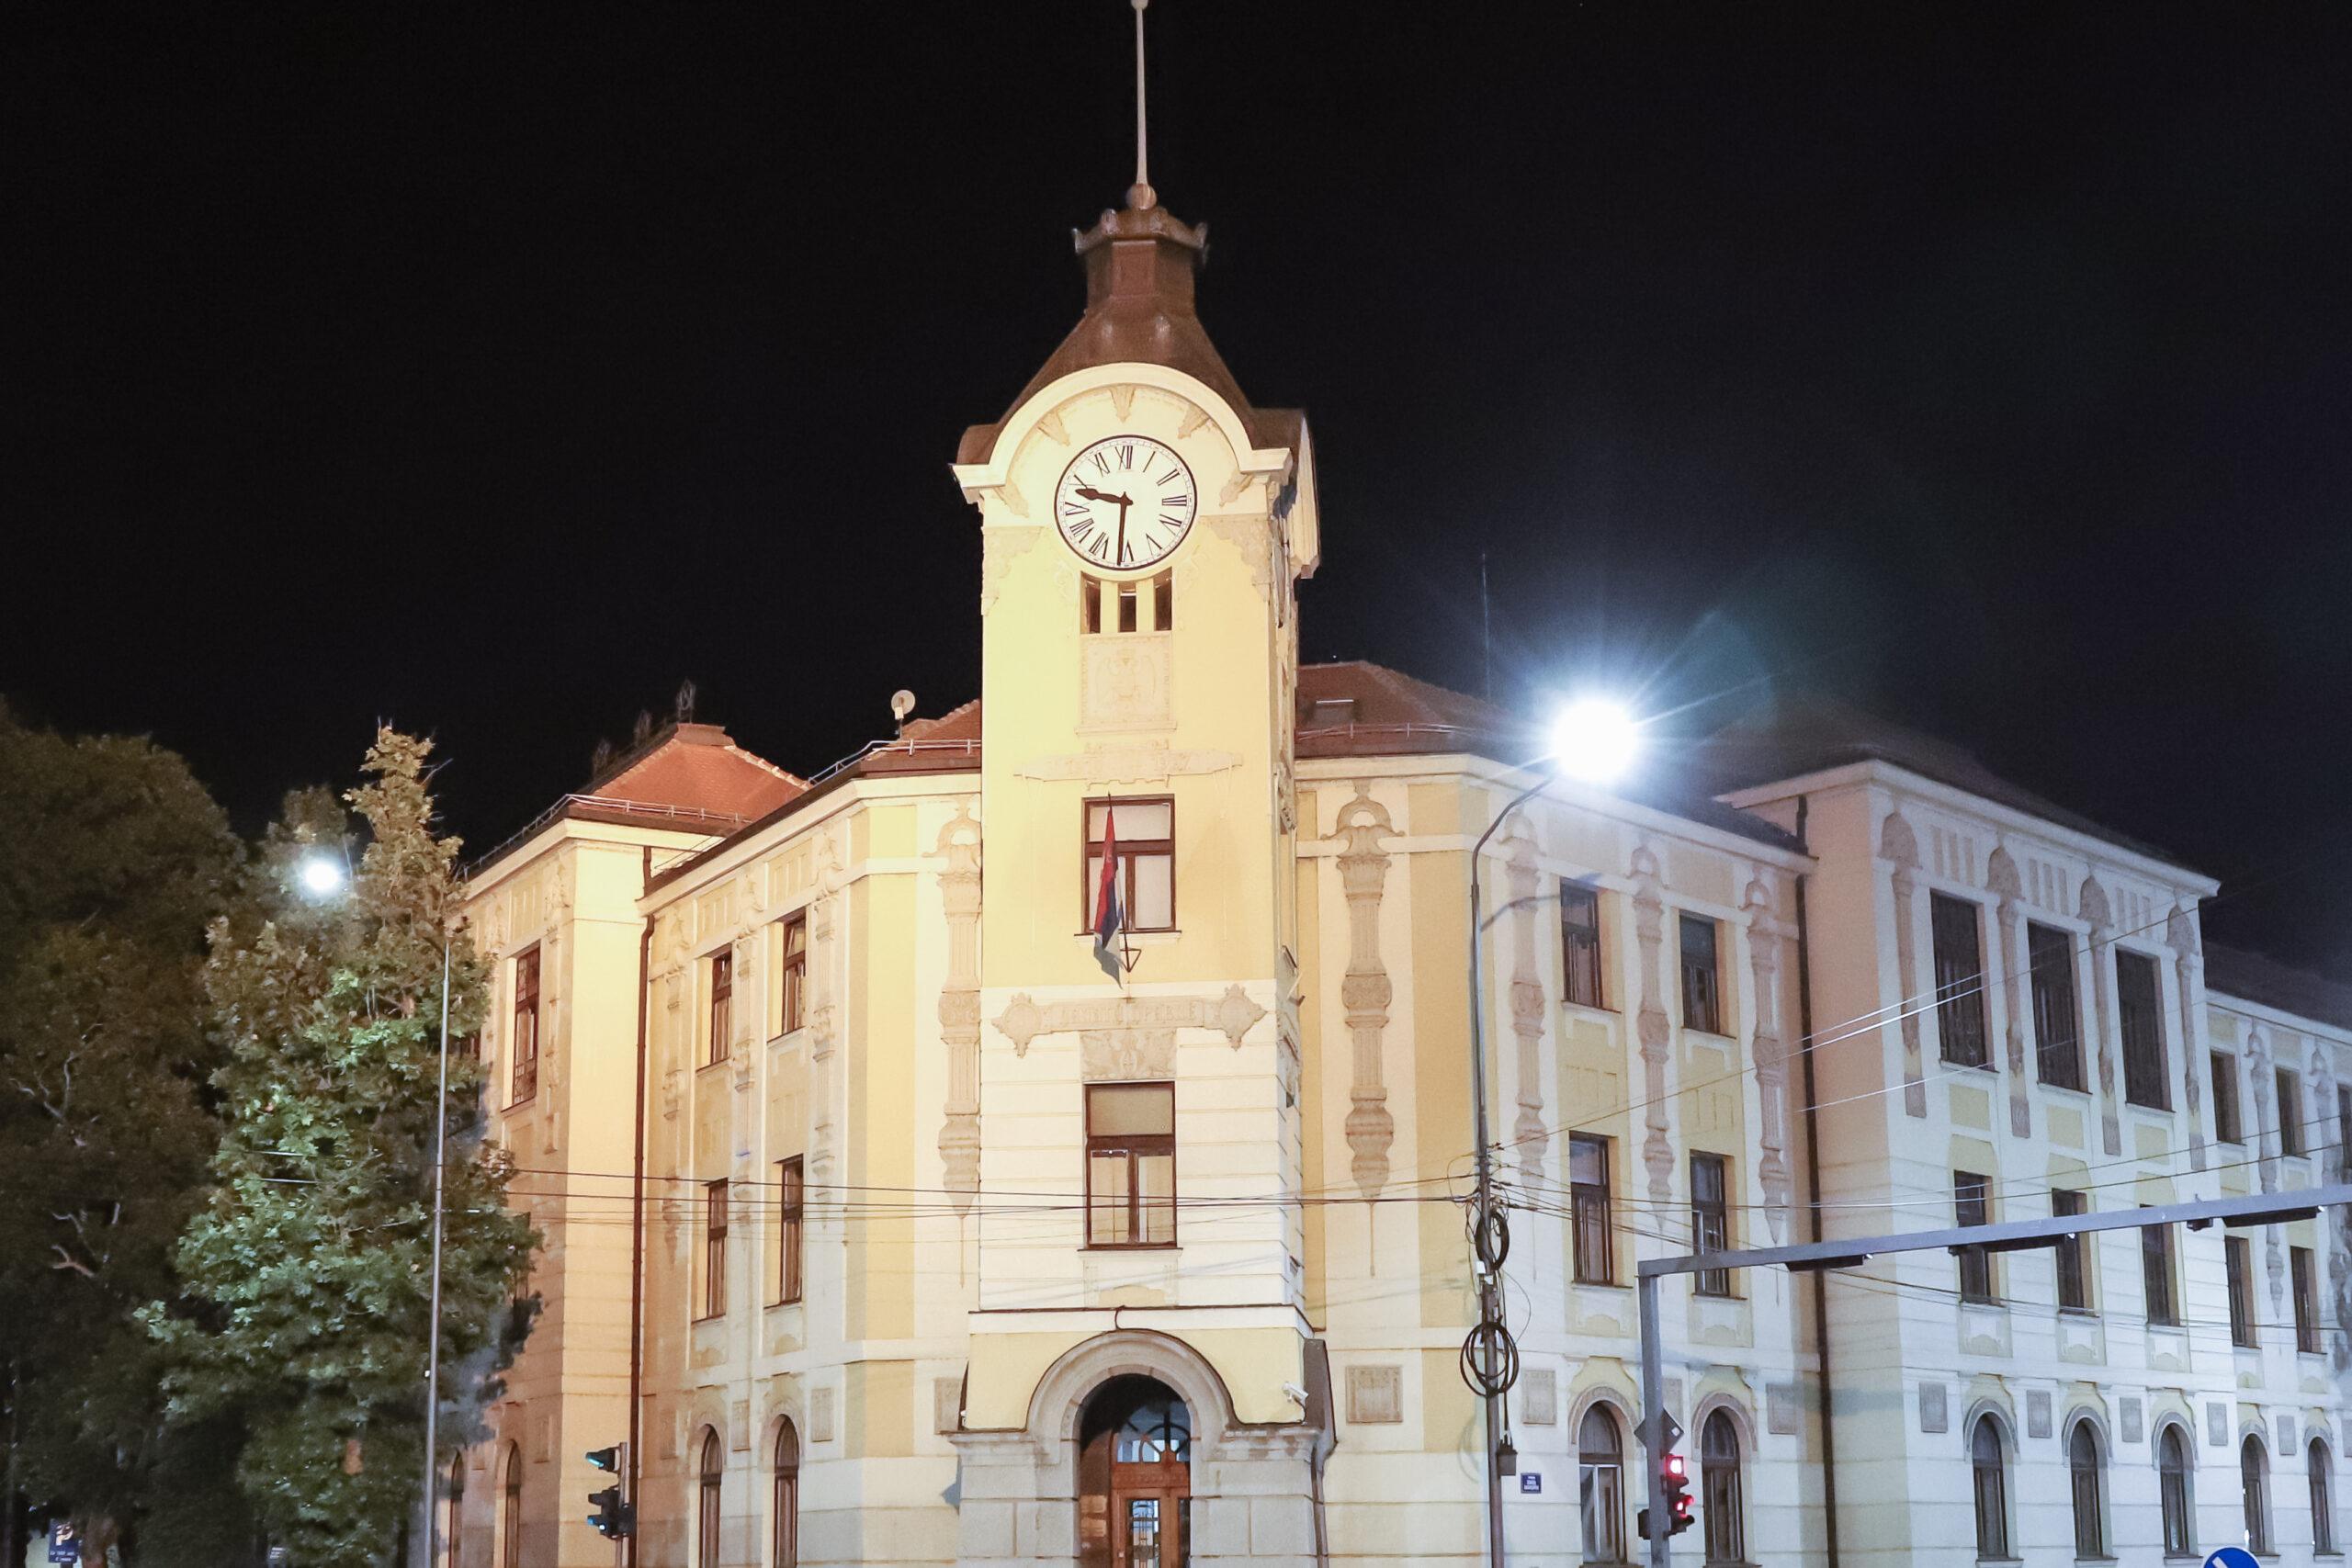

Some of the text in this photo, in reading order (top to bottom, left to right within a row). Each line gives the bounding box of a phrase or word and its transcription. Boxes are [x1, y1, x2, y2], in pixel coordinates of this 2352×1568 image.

[1088, 452, 1110, 478] XI
[1114, 446, 1133, 470] XII
[1142, 450, 1156, 473] I
[1156, 468, 1180, 486] II
[1064, 502, 1091, 516] IX
[1161, 494, 1187, 506] III
[1069, 517, 1094, 544] VIII
[1159, 513, 1182, 536] IV
[1088, 531, 1109, 559] VII
[1145, 533, 1163, 557] V
